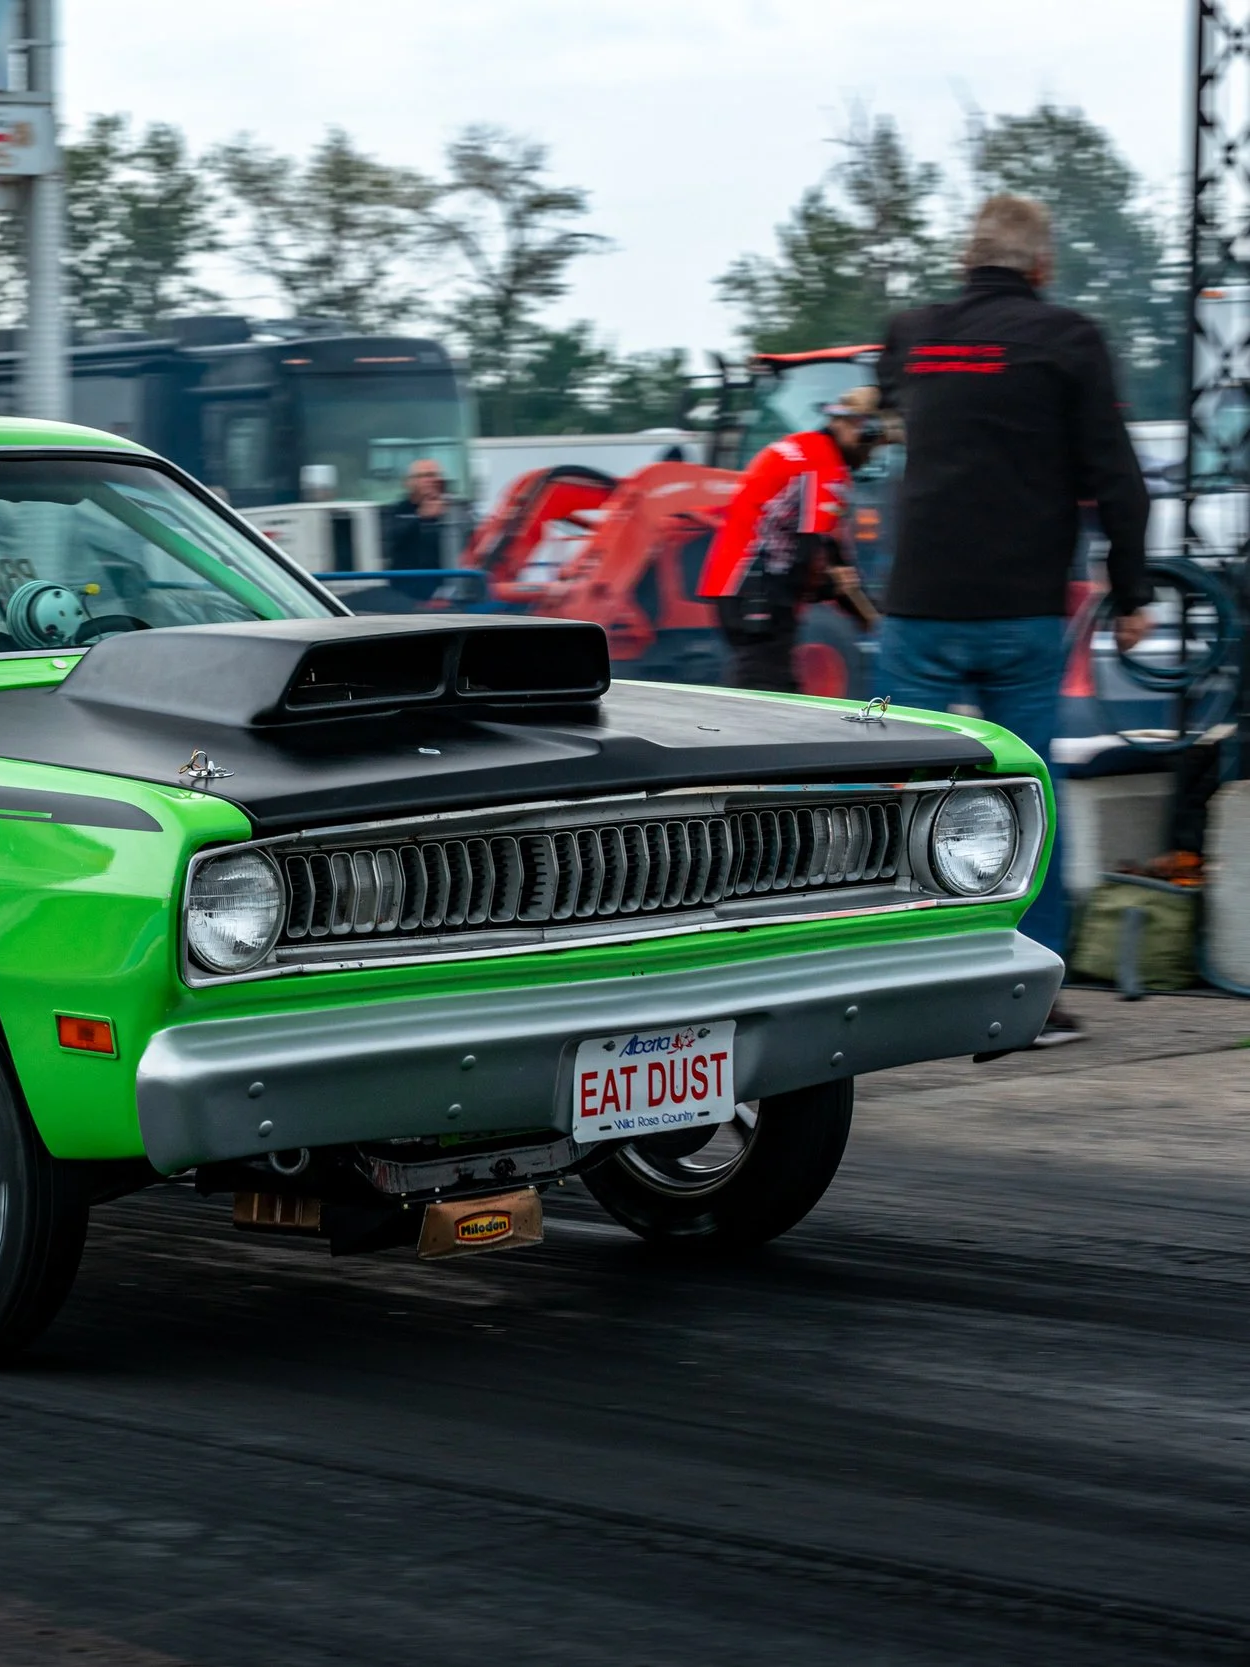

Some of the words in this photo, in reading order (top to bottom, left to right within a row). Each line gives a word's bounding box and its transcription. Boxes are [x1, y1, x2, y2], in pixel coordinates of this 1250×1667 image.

[619, 1034, 671, 1058] Alberta
[580, 1065, 638, 1118] EAT
[648, 1052, 728, 1107] DUST
[614, 1117, 635, 1130] Wild
[638, 1116, 660, 1127] Rose
[662, 1111, 695, 1124] Country
[460, 1220, 507, 1236] Milodon
